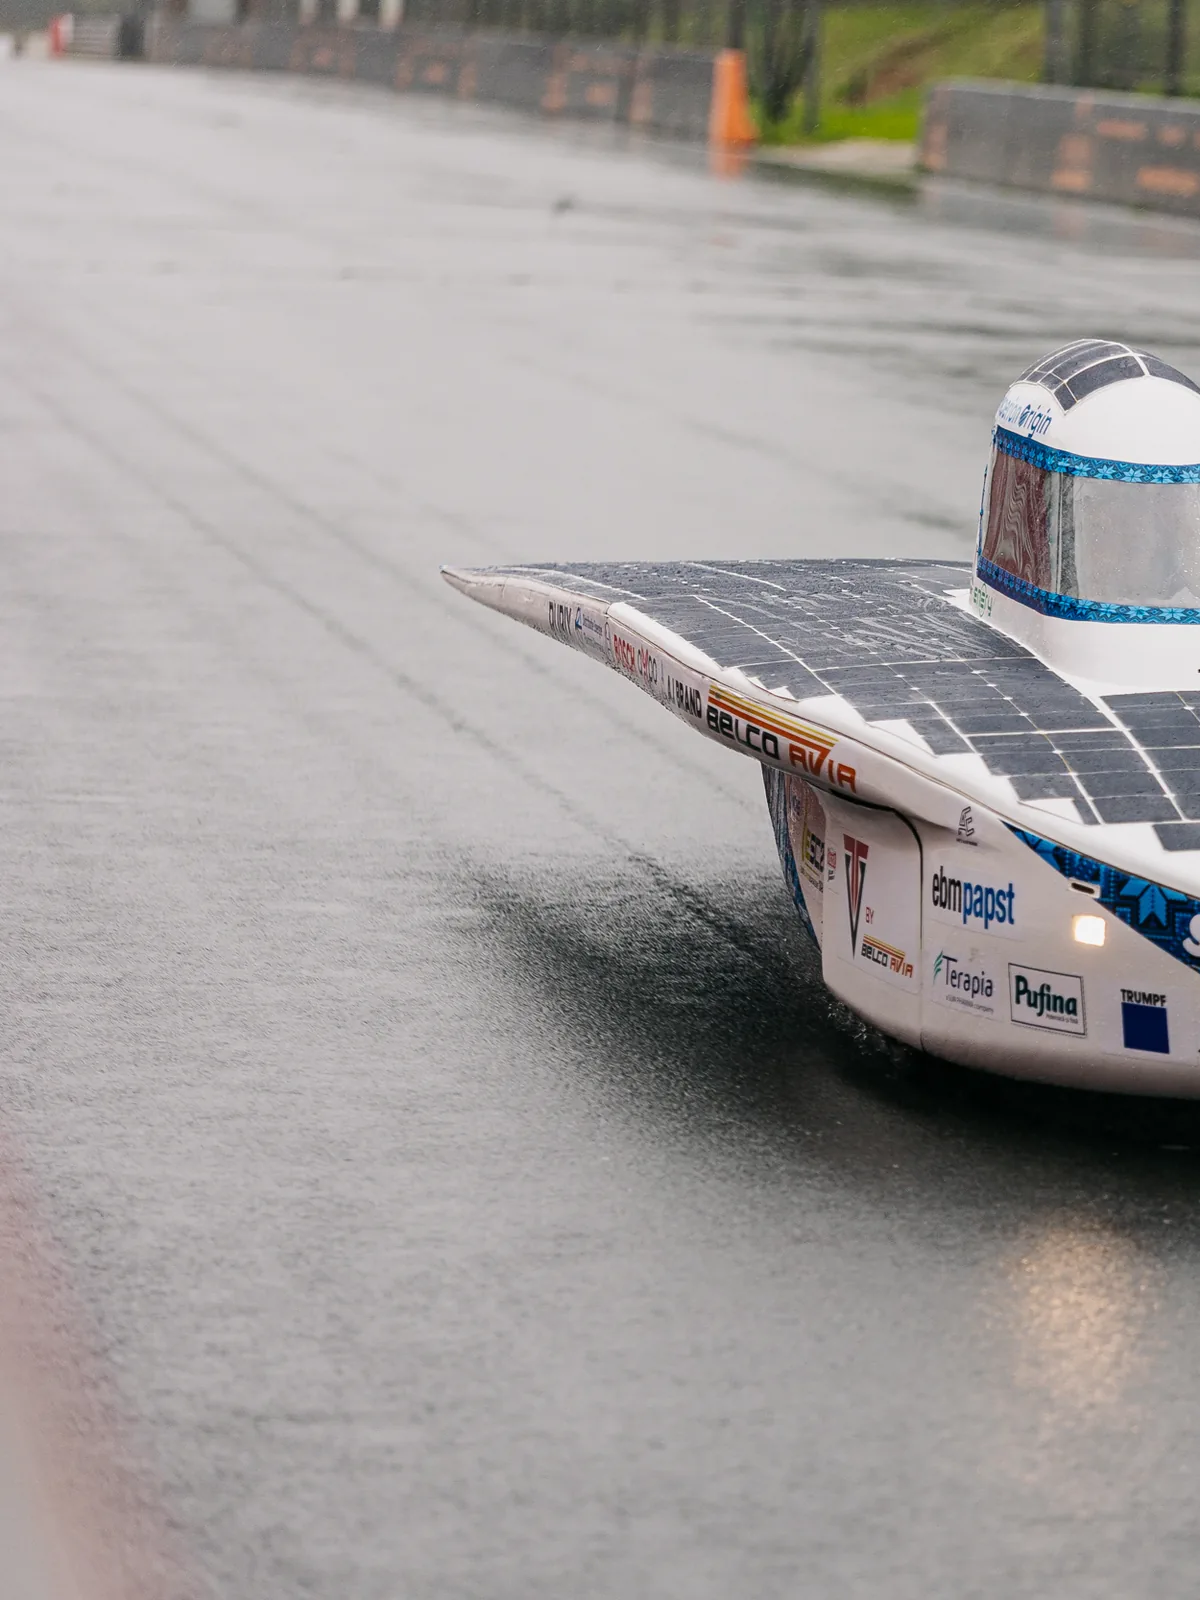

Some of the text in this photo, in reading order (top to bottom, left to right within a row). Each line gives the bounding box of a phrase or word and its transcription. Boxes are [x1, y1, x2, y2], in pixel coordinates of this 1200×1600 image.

[706, 704, 857, 793] BELCO AVIA
[865, 906, 875, 925] BY
[932, 865, 1015, 929] ebmpapst
[861, 943, 888, 967] BELCO
[942, 955, 994, 999] Terapia
[1014, 975, 1078, 1017] Pufina
[1120, 988, 1167, 1007] TRUMPF
